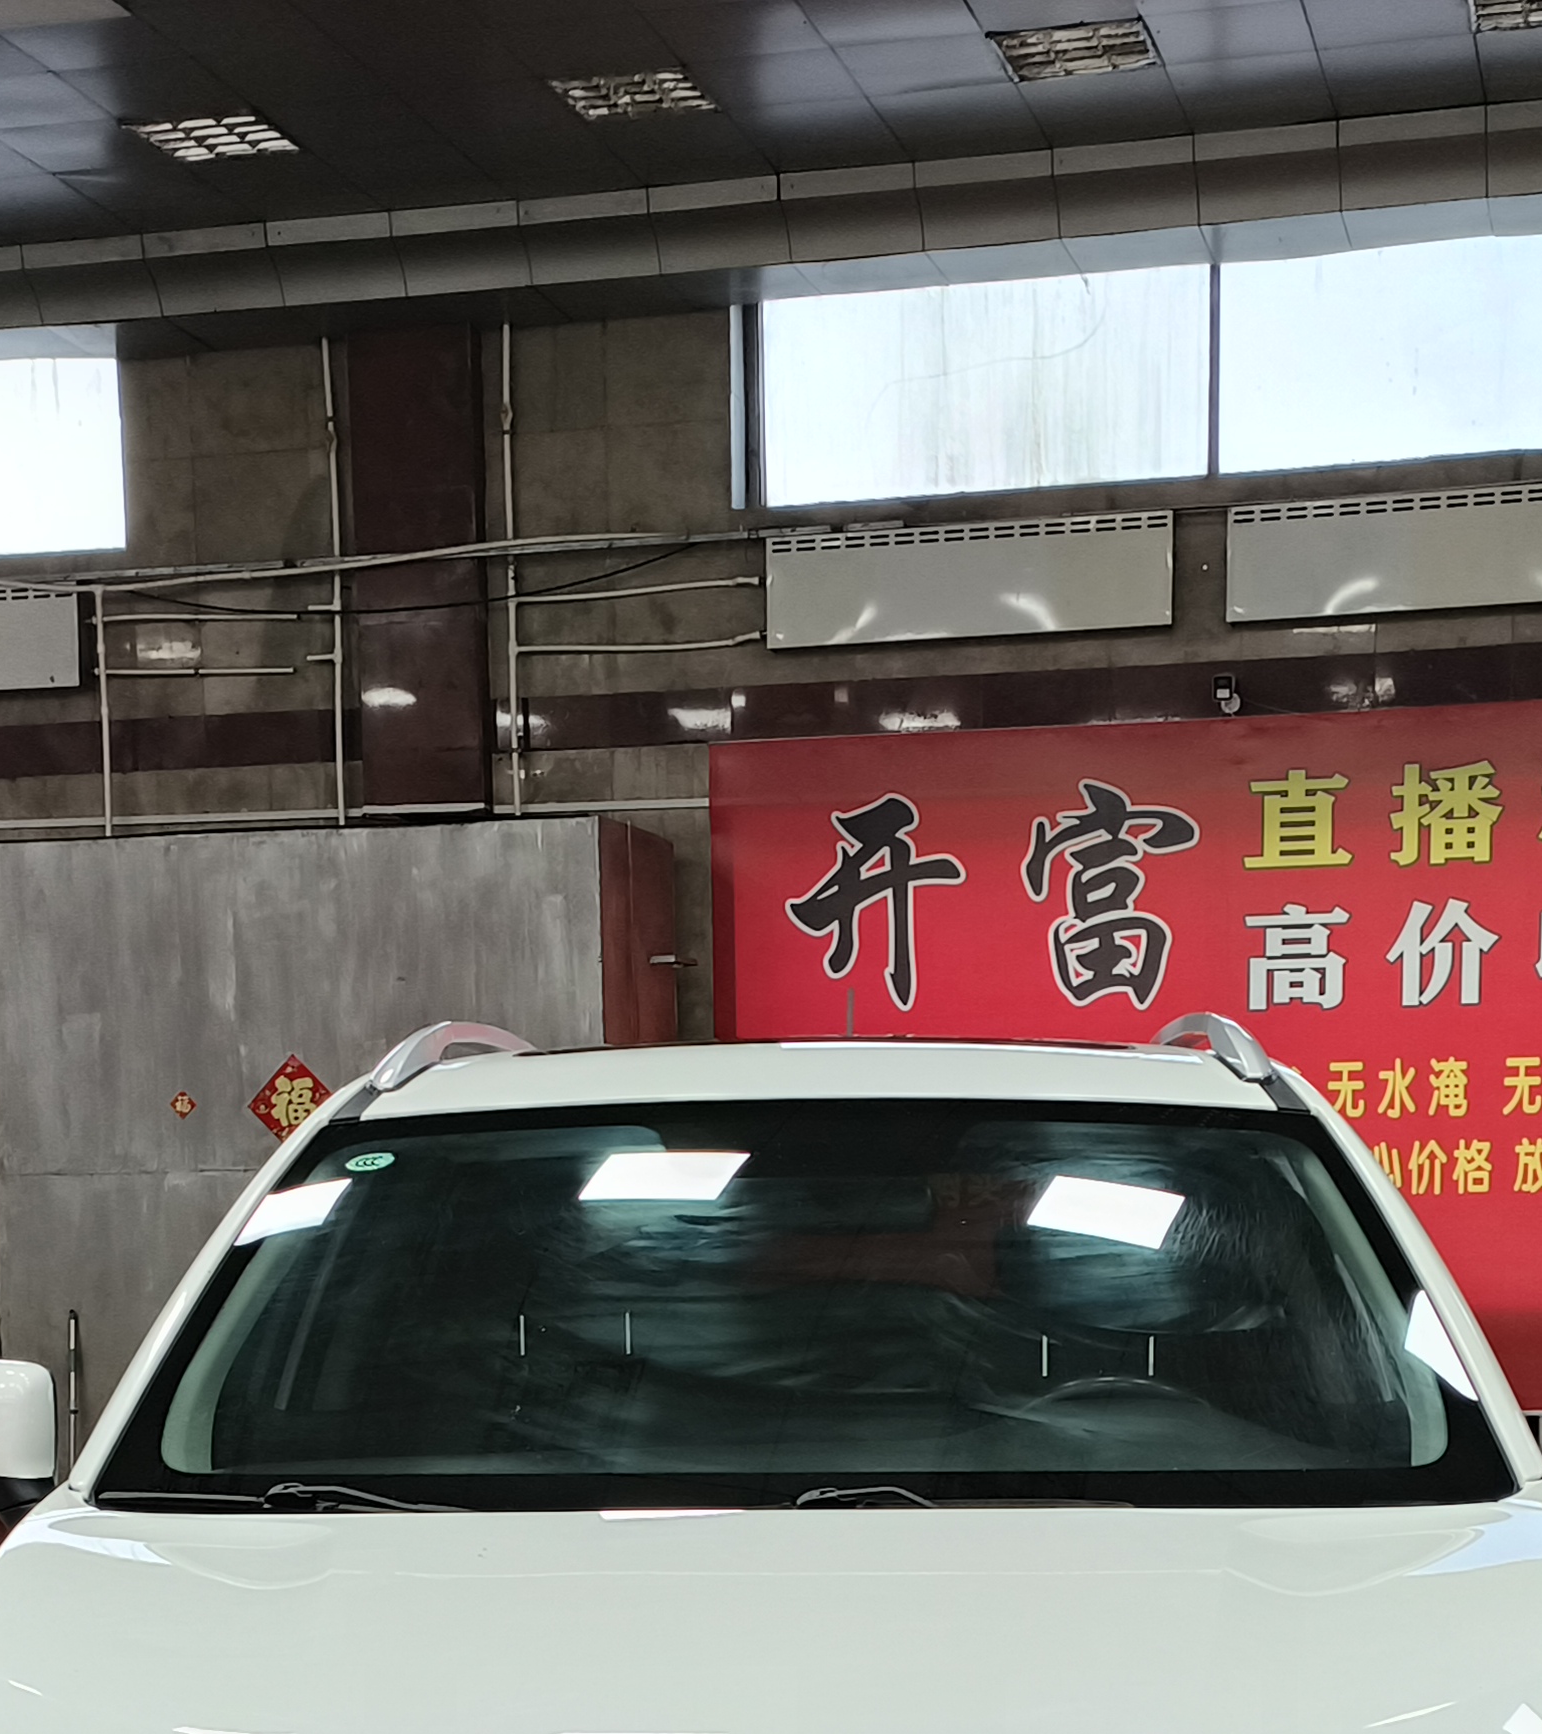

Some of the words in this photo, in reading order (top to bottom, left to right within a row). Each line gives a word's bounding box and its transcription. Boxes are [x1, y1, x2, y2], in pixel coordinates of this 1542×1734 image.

[787, 779, 1201, 1010] 开富
[271, 1075, 317, 1127] 福
[1326, 1057, 1469, 1119] 无水淹
